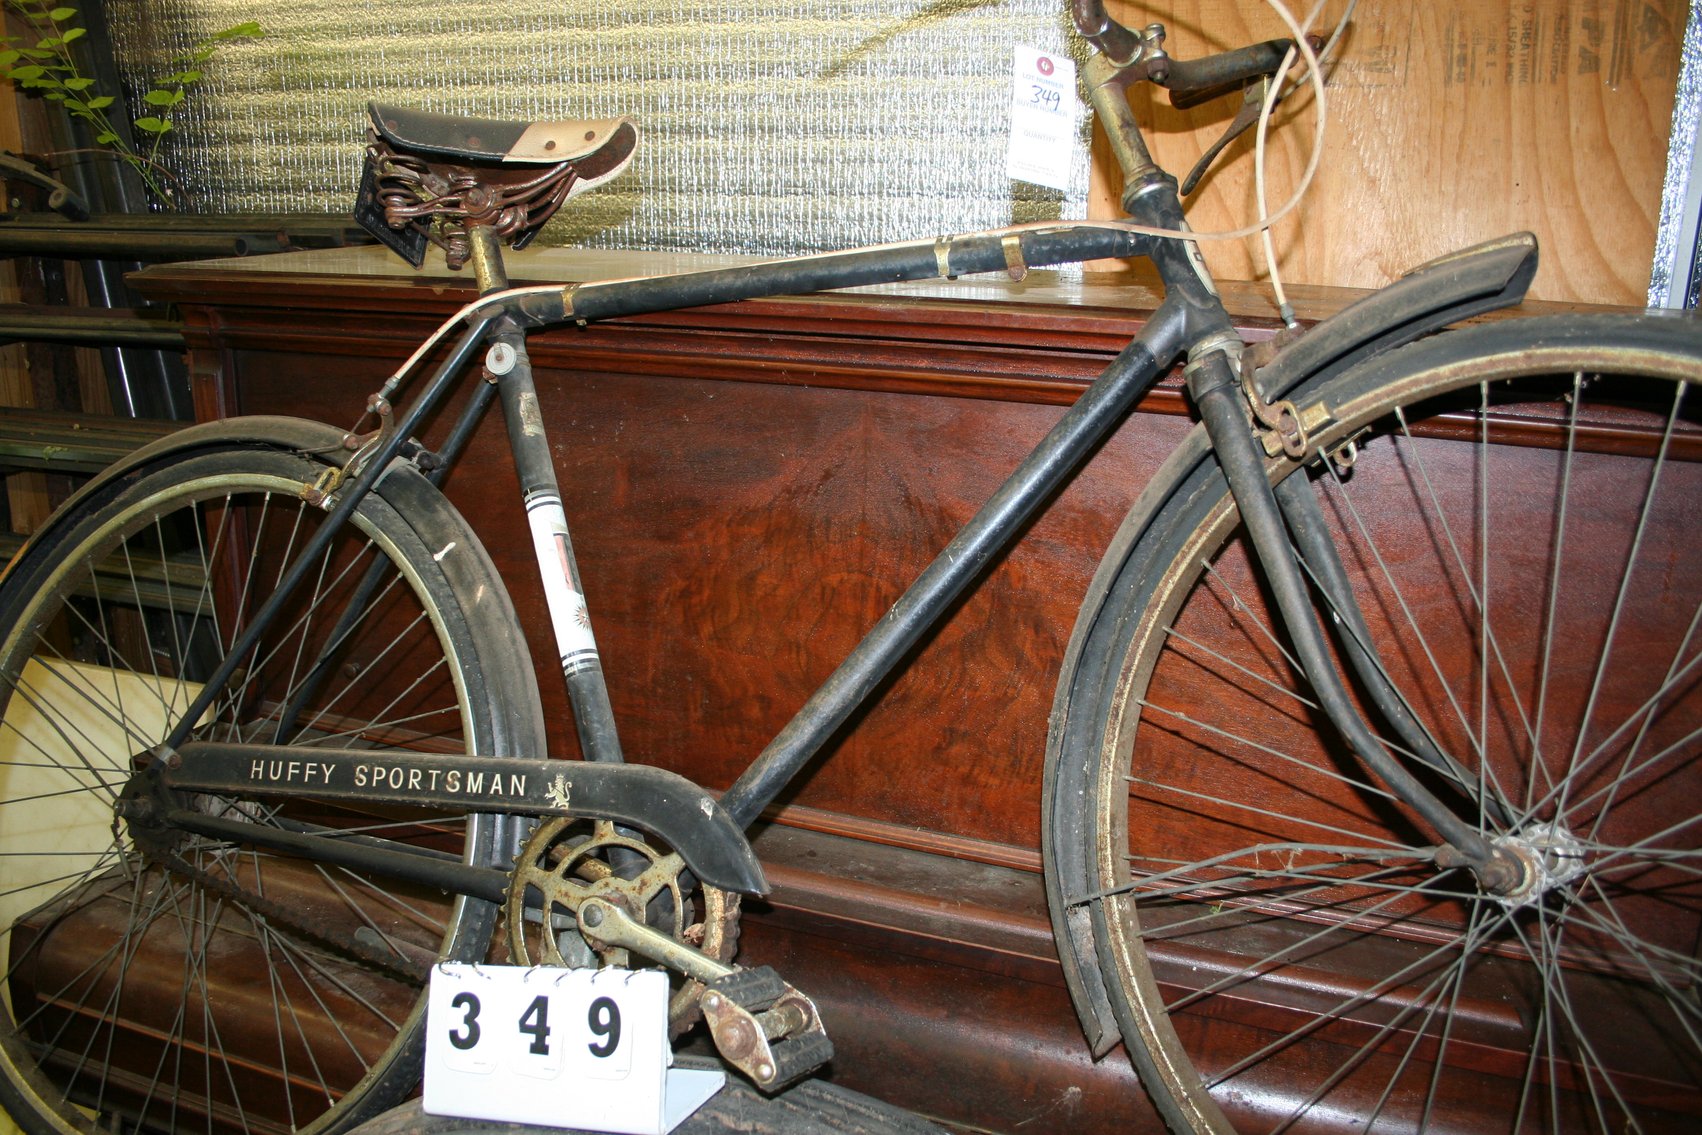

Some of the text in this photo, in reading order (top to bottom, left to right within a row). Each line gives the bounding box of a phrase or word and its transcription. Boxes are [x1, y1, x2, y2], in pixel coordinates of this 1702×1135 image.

[1022, 72, 1064, 89] LOT NUMBER
[1016, 98, 1039, 110] BUYER
[1030, 84, 1060, 112] 349
[1023, 129, 1057, 143] QUANTITY
[249, 759, 527, 797] HUFFY SPORTSMAN
